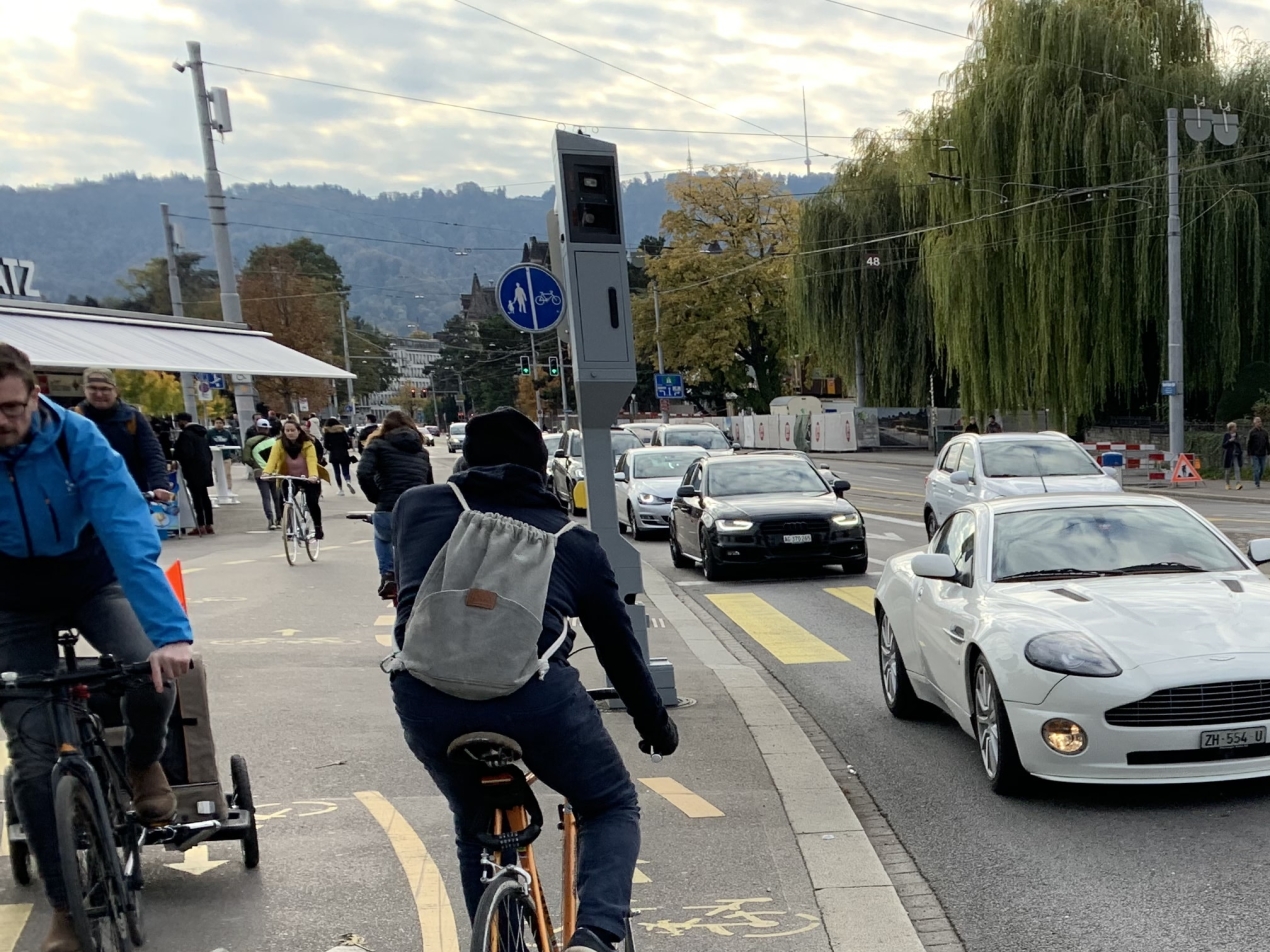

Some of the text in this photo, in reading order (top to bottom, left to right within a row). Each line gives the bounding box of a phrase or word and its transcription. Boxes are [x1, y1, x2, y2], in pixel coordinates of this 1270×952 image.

[866, 256, 880, 266] 48
[1205, 730, 1263, 746] ZH 554 U
